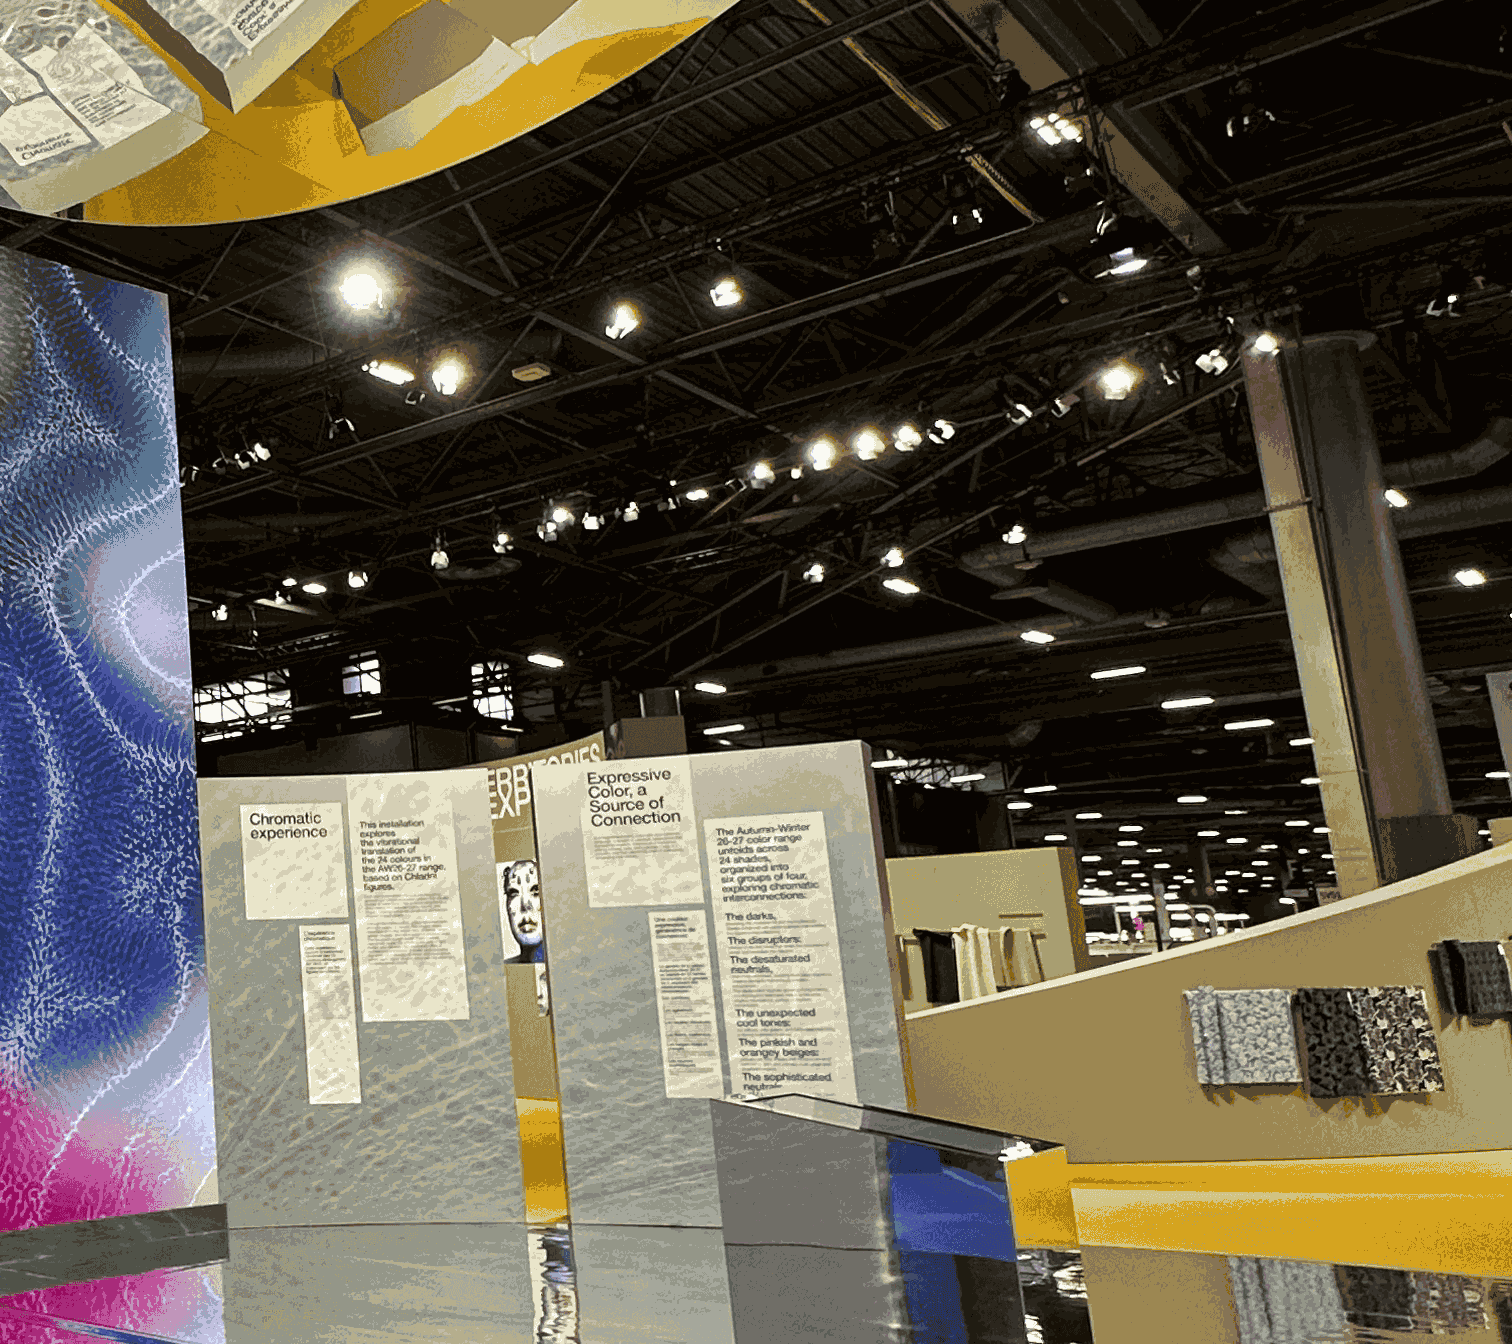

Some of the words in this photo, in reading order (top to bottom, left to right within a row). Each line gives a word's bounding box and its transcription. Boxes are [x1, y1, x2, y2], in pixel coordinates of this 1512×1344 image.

[587, 768, 672, 786] Expressive
[588, 785, 633, 799] Color,
[637, 786, 648, 797] a
[589, 799, 645, 813] Source
[648, 795, 665, 810] of
[249, 811, 322, 826] Chromatic
[360, 820, 377, 829] This
[378, 819, 425, 829] installation
[590, 810, 681, 827] Connection
[250, 827, 328, 842] experience
[359, 830, 396, 839] explores
[716, 827, 735, 837] The
[360, 838, 374, 847] the
[746, 835, 772, 845] color
[773, 834, 803, 844] range
[407, 845, 417, 855] of
[756, 844, 790, 853] across
[361, 856, 376, 865] the
[362, 864, 376, 874] the
[720, 865, 769, 876] organized
[770, 863, 790, 872] into
[362, 874, 390, 883] based
[736, 875, 772, 886] groups
[773, 872, 784, 882] of
[722, 884, 768, 895] exploring
[769, 881, 820, 892] chromatic
[725, 912, 744, 922] The
[727, 936, 746, 946] The
[729, 955, 749, 965] The
[750, 953, 811, 965] desaturated
[734, 1007, 755, 1018] The
[756, 1007, 816, 1019] unexpected
[736, 1018, 759, 1028] cool
[738, 1037, 758, 1047] The
[797, 1037, 818, 1048] and
[741, 1071, 762, 1082] The
[763, 1071, 833, 1083] sophisticated
